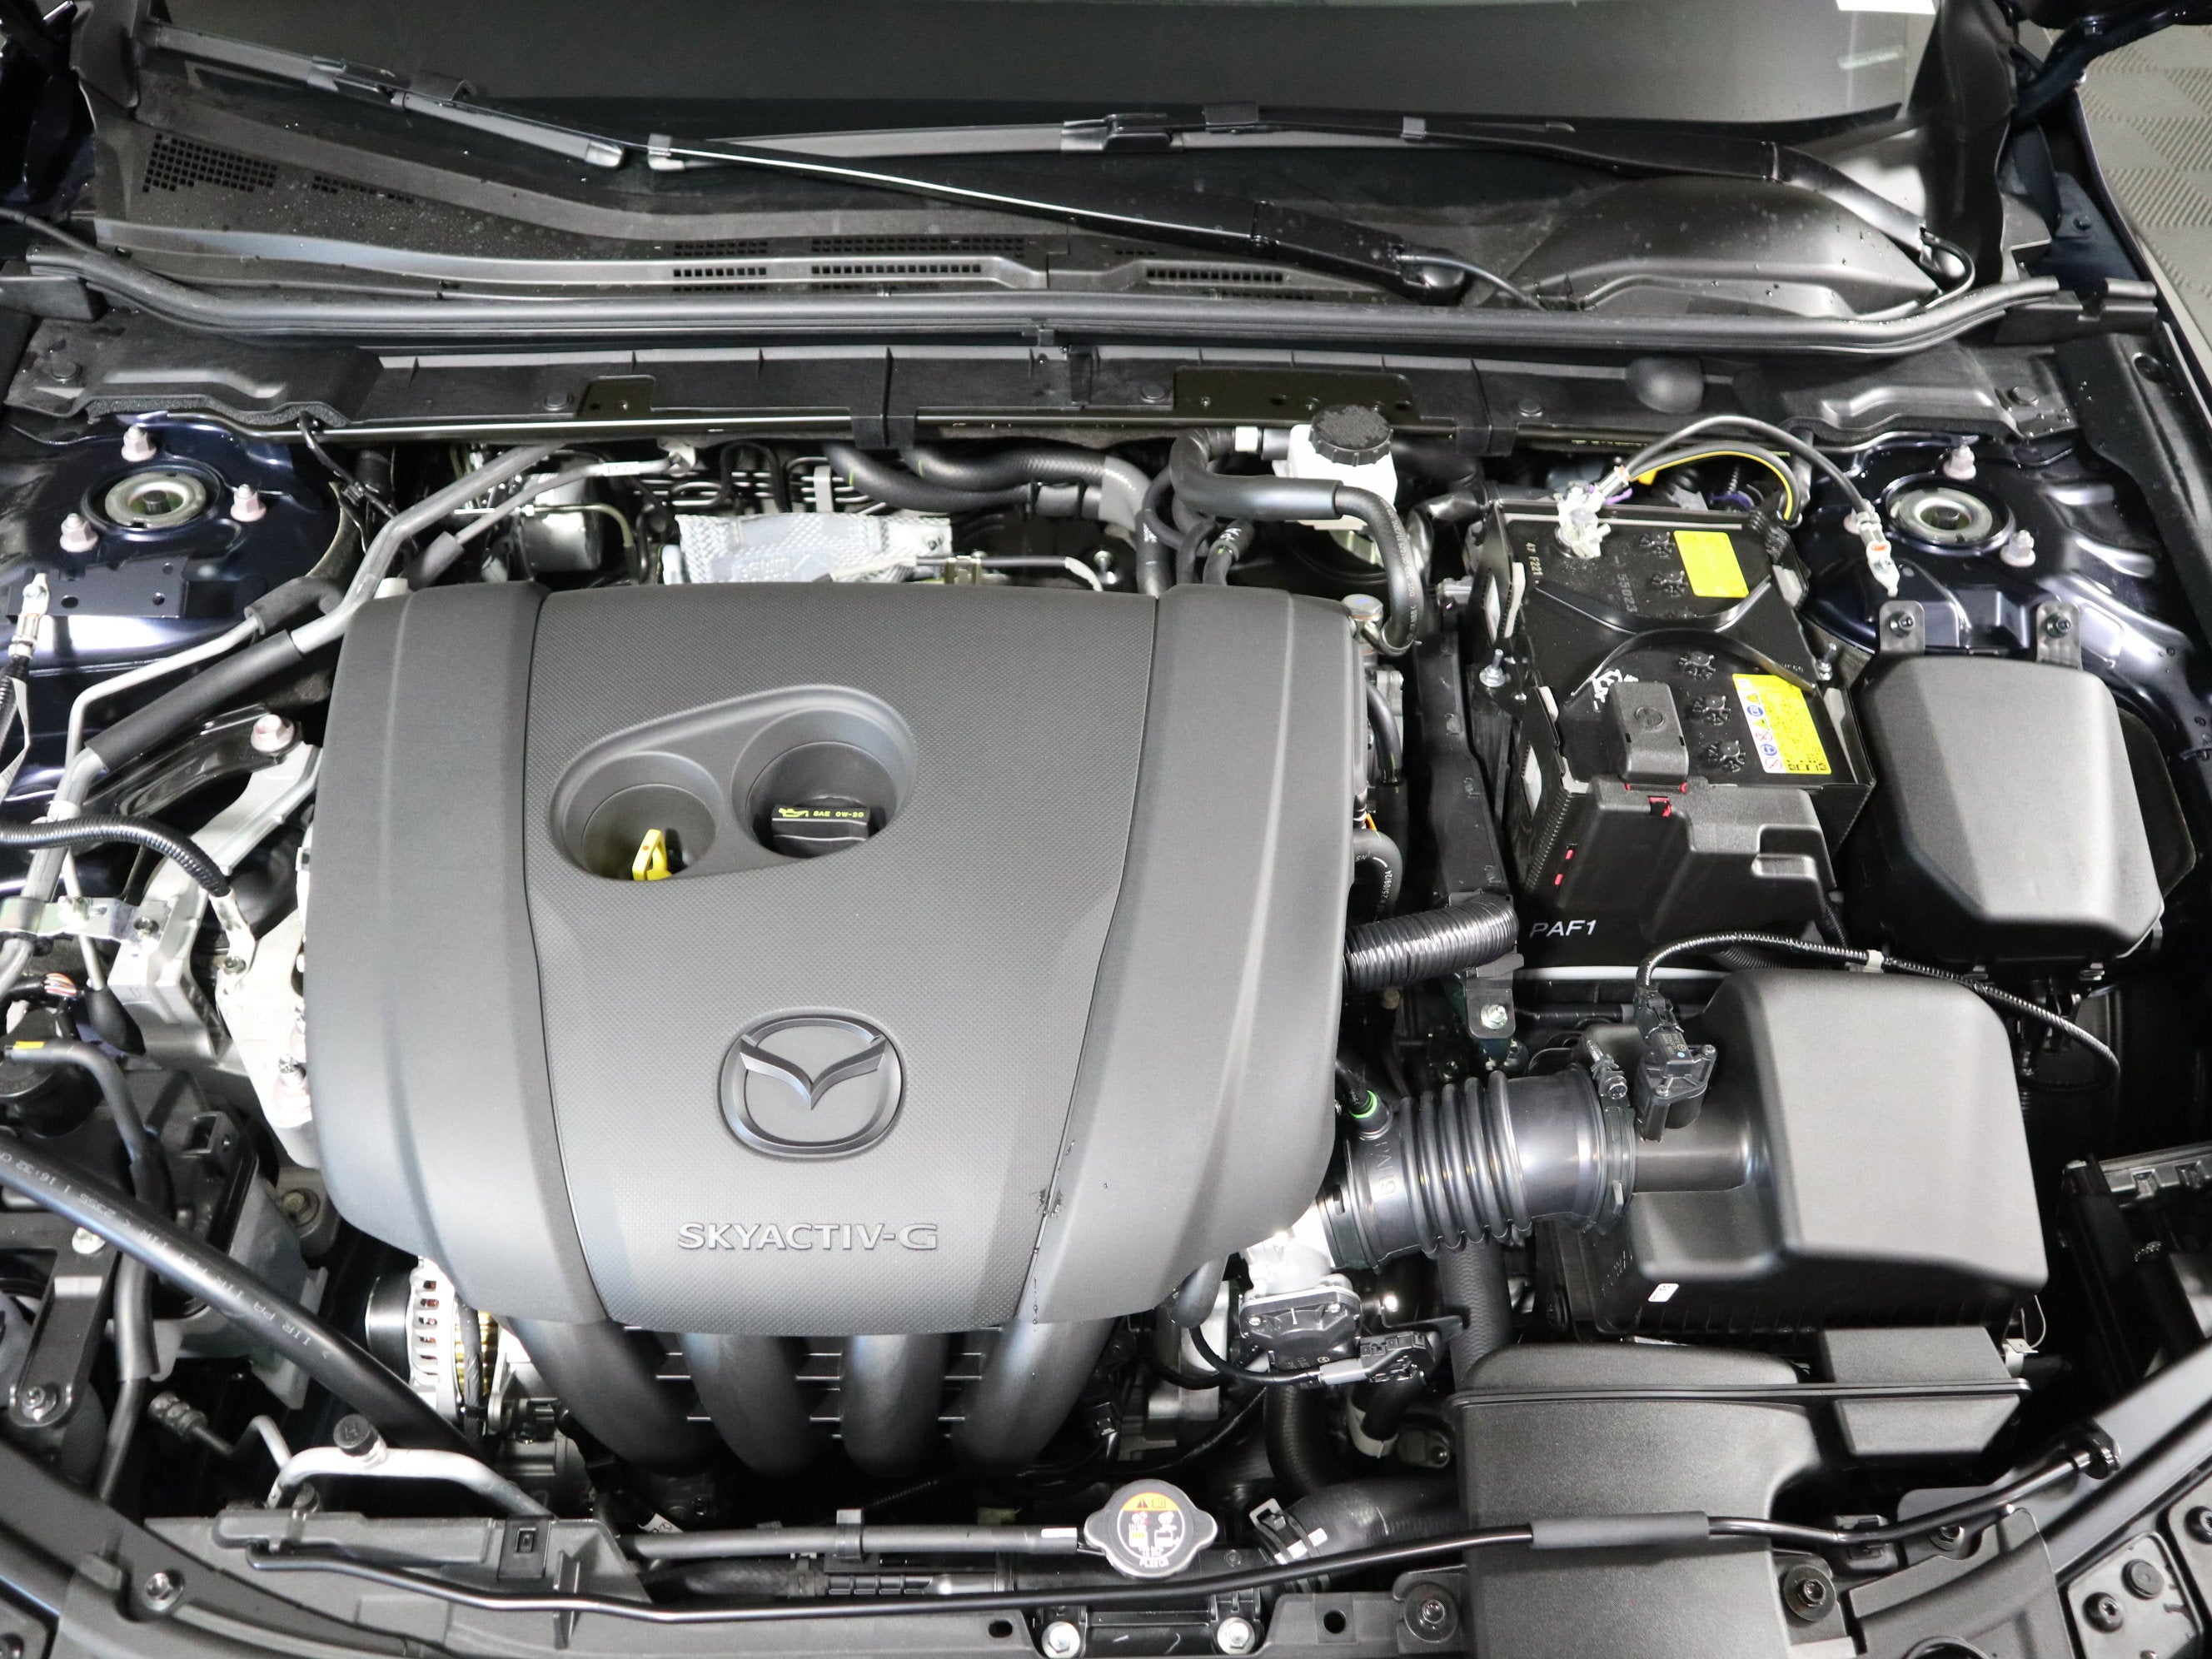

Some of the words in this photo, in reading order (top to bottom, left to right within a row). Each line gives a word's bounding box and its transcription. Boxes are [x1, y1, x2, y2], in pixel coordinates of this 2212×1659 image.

[1617, 573, 1638, 612] 55023
[1529, 919, 1597, 938] PAF1
[677, 1221, 939, 1250] SKYACTIV-G
